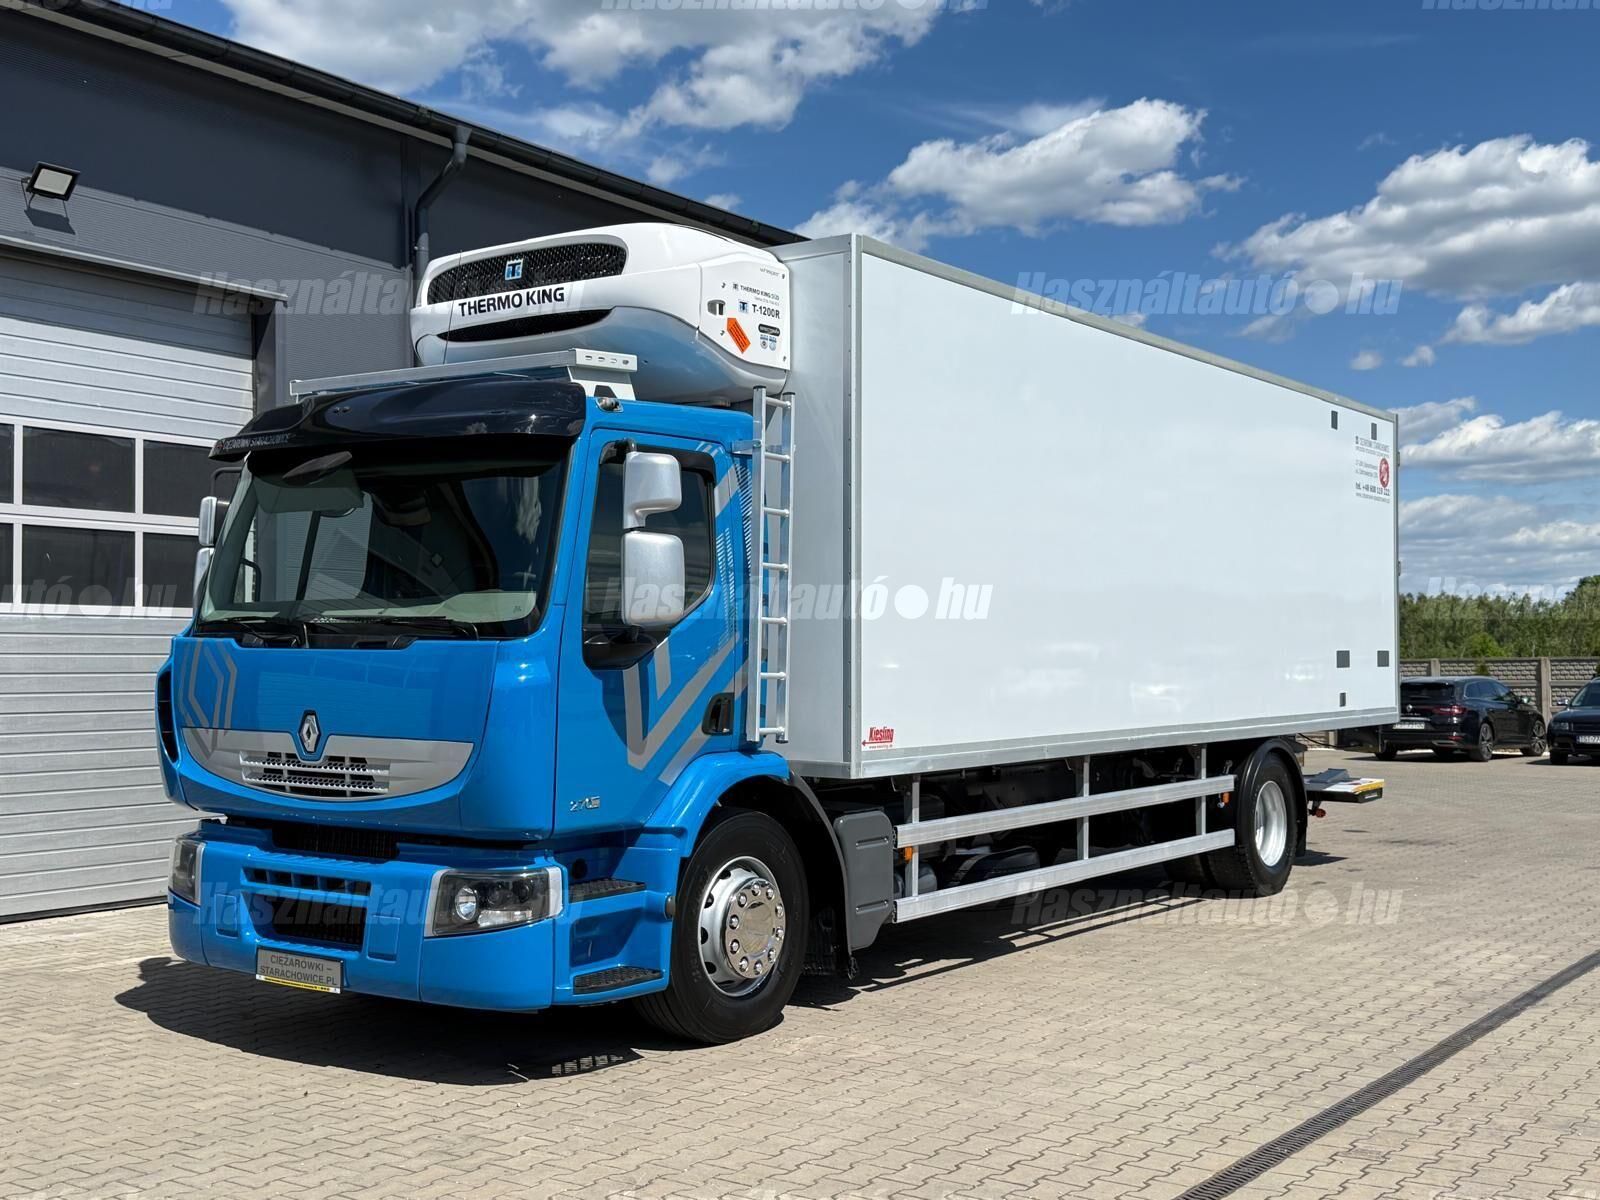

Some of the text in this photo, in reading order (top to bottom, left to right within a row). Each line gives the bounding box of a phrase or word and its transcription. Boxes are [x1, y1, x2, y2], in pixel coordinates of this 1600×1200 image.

[740, 284, 760, 296] THERMO
[458, 292, 523, 317] THERMO
[526, 286, 565, 306] KING
[751, 303, 781, 320] T-1200R
